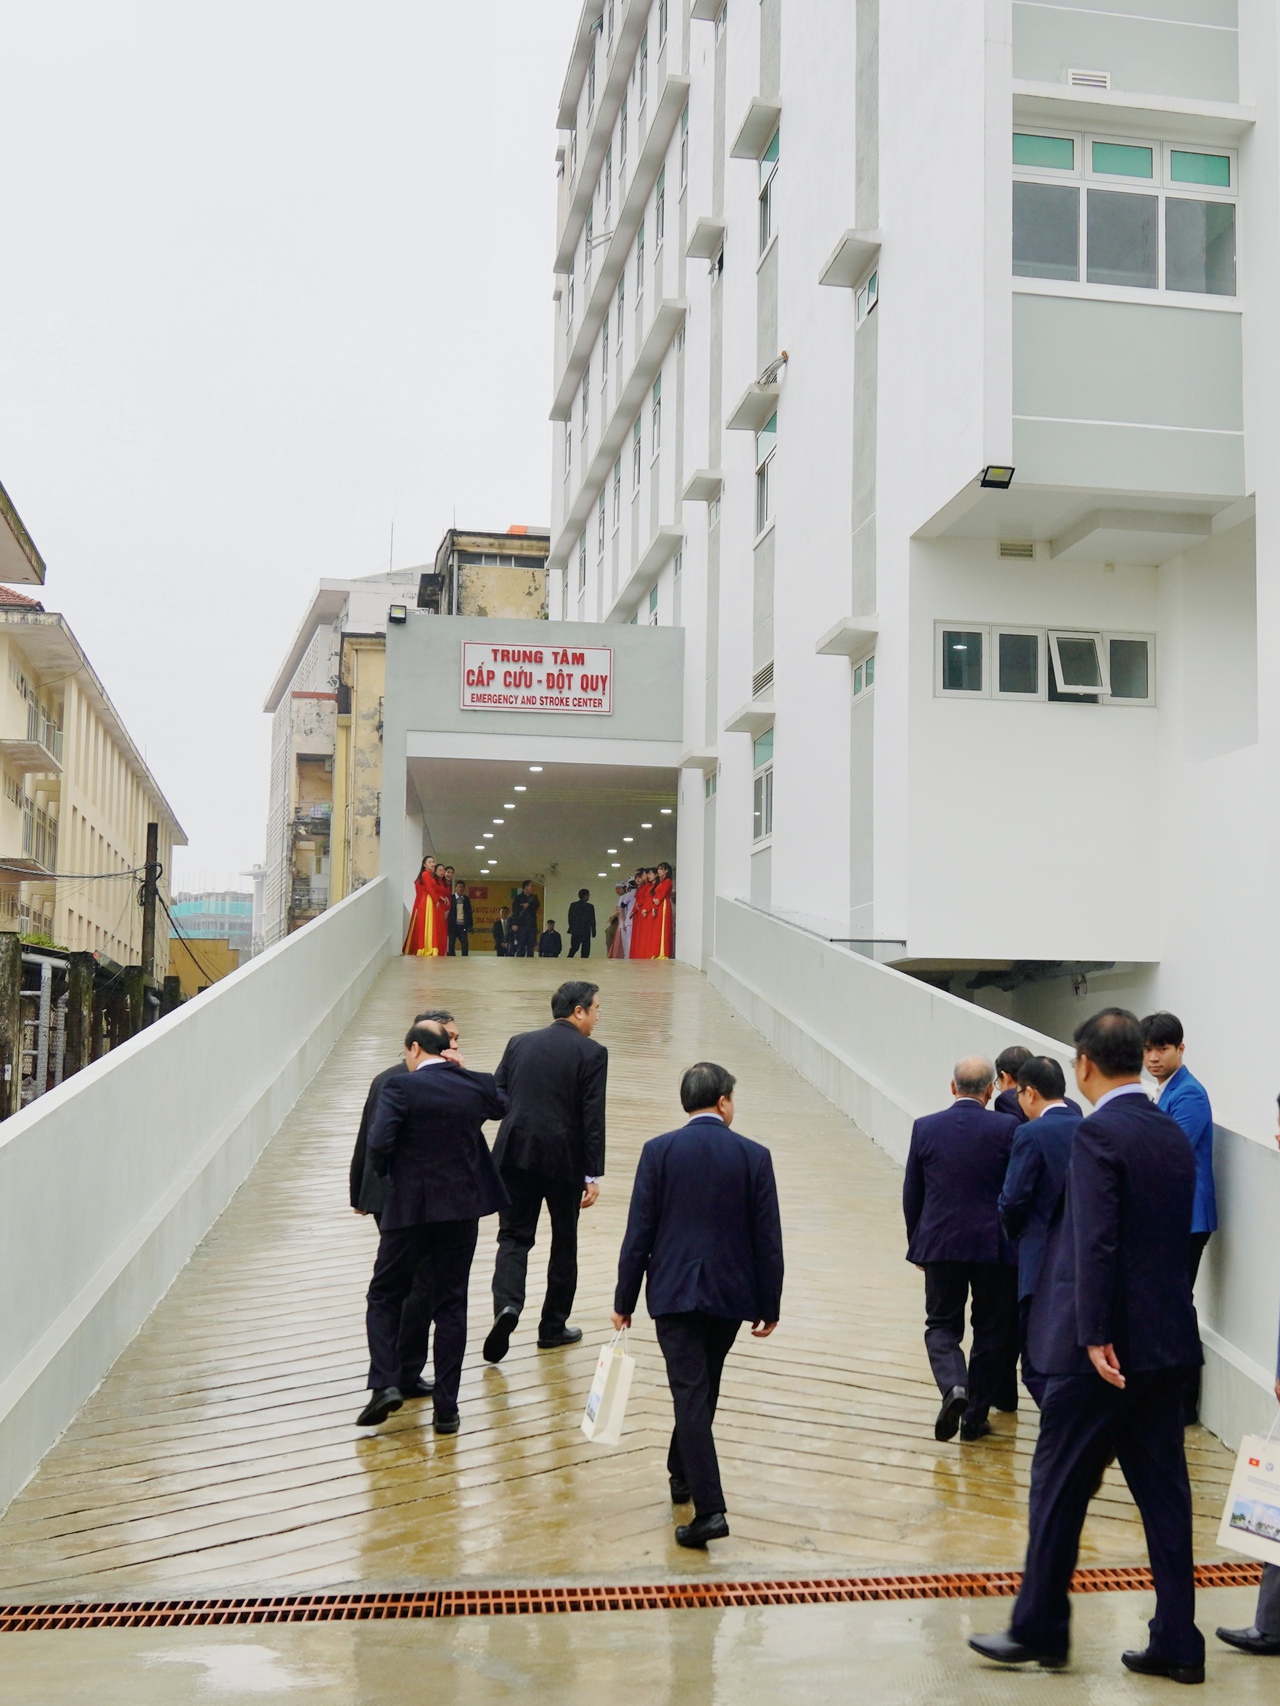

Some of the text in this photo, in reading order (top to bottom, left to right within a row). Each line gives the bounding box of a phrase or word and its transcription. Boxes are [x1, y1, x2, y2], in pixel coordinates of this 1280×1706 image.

[491, 648, 585, 666] TRUNG TÂM
[466, 662, 496, 687] CẤP
[503, 666, 533, 689] CỨU
[546, 668, 574, 694] ĐỘT
[580, 673, 608, 696] QUỴ
[470, 693, 603, 708] EMERGENCY AND STROKE CENTER
